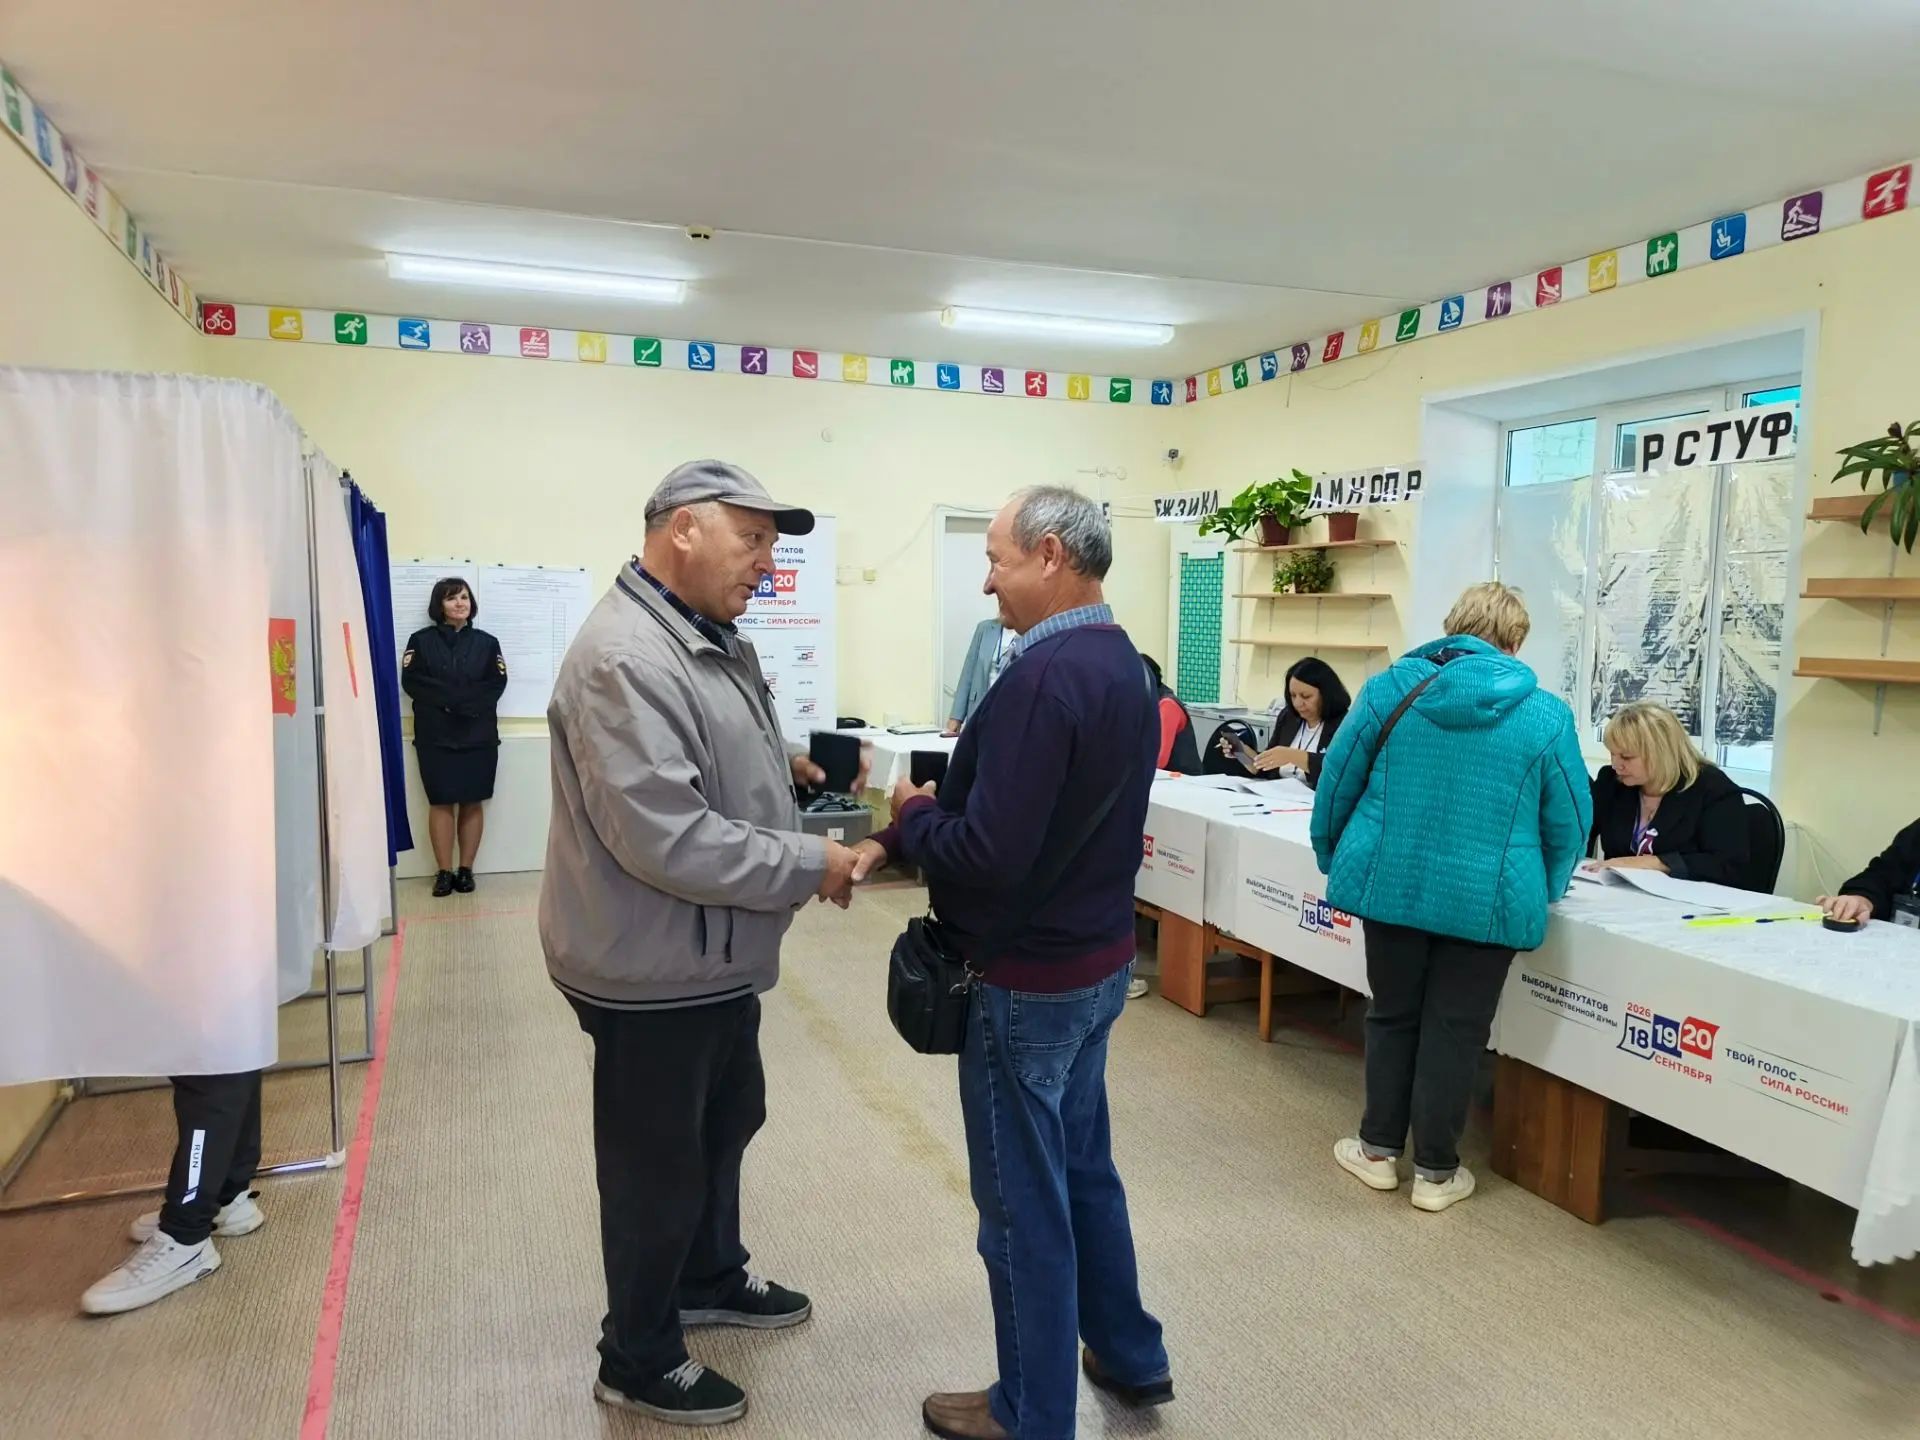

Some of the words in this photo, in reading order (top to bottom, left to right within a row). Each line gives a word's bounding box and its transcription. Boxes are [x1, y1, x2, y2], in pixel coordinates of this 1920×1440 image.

[1643, 411, 1792, 473] РСТУФ
[775, 574, 794, 587] 20
[1304, 909, 1316, 925] 18
[1318, 905, 1331, 923] 19
[1318, 928, 1351, 945] СЕНТЯБРЯ
[1521, 973, 1557, 993] ВЫБОРЫ
[1558, 987, 1609, 1012] ДЕПУТАТОВ
[1530, 989, 1595, 1020] ГОСУДАРСТВЕННОЙ
[1596, 1014, 1618, 1027] ДУМЫ
[1627, 1002, 1651, 1018] 2026
[1628, 1026, 1649, 1049] 18
[1654, 1024, 1677, 1049] 19
[1682, 1023, 1712, 1051] 20
[1654, 1055, 1712, 1084] СЕНТЯБРЯ
[1725, 1047, 1755, 1067] ТВОЙ
[1758, 1060, 1797, 1081] ГОЛОС
[1760, 1075, 1793, 1095] СИЛА
[1795, 1087, 1849, 1116] РОССИИ!
[192, 1144, 201, 1168] RUN
